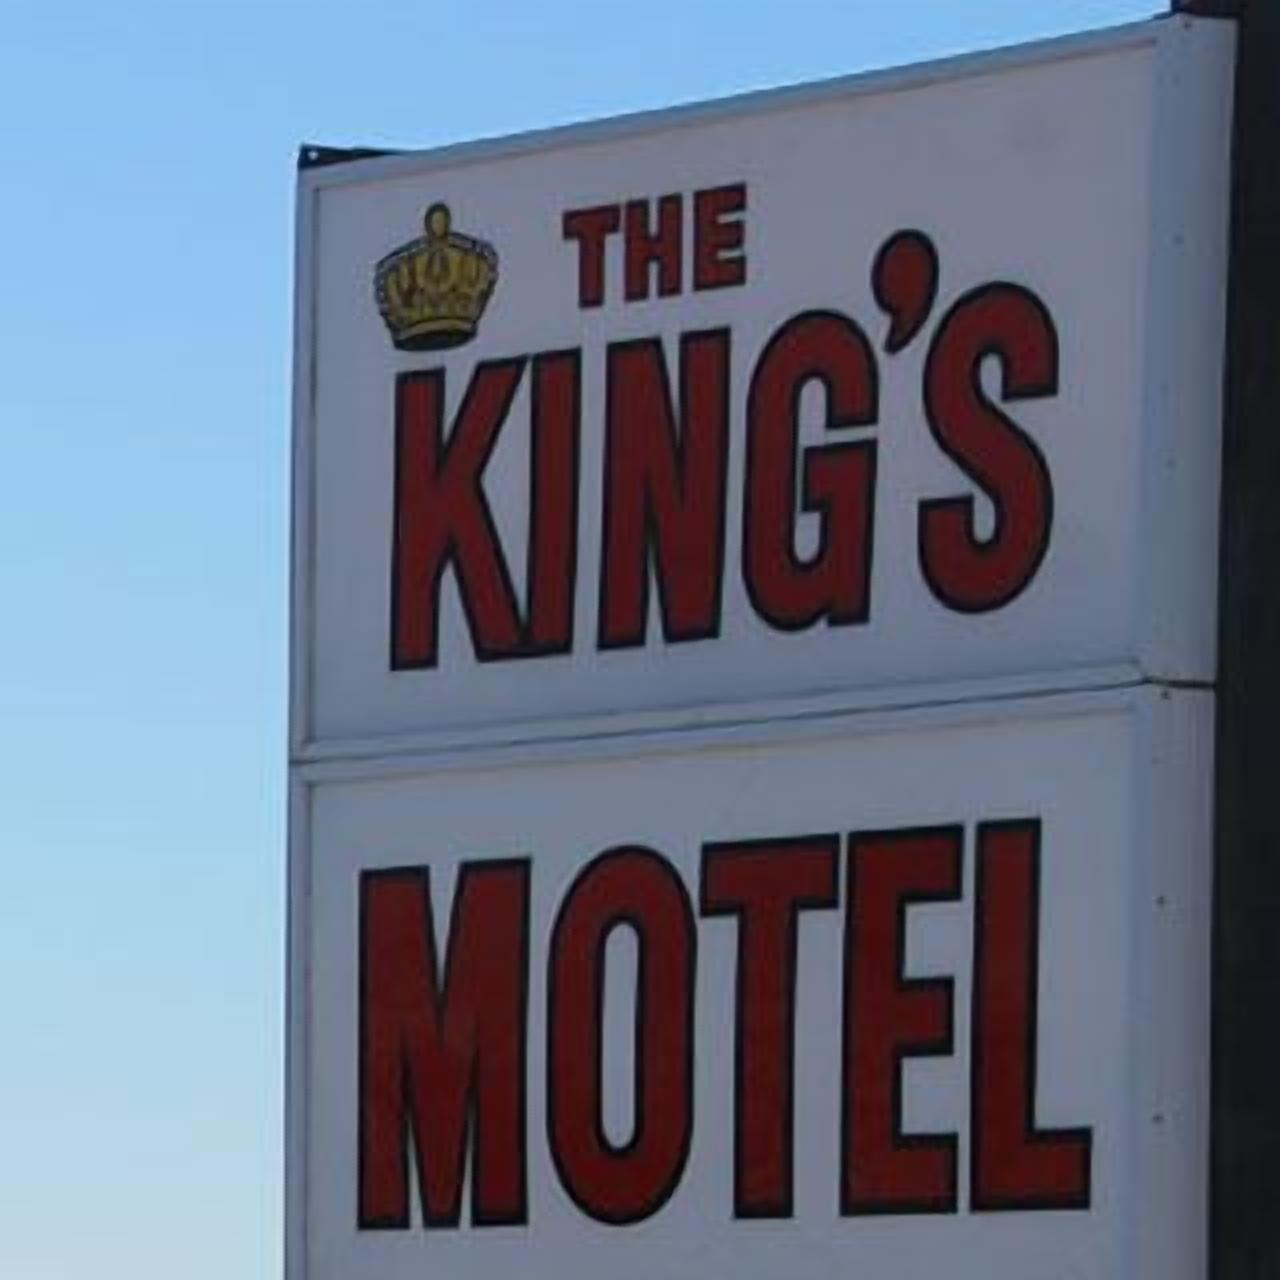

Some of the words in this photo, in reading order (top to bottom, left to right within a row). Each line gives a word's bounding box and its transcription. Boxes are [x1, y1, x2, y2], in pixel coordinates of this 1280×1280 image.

[389, 227, 1060, 672] KING'S
[562, 180, 748, 309] THE
[356, 816, 1093, 1231] MOTEL
